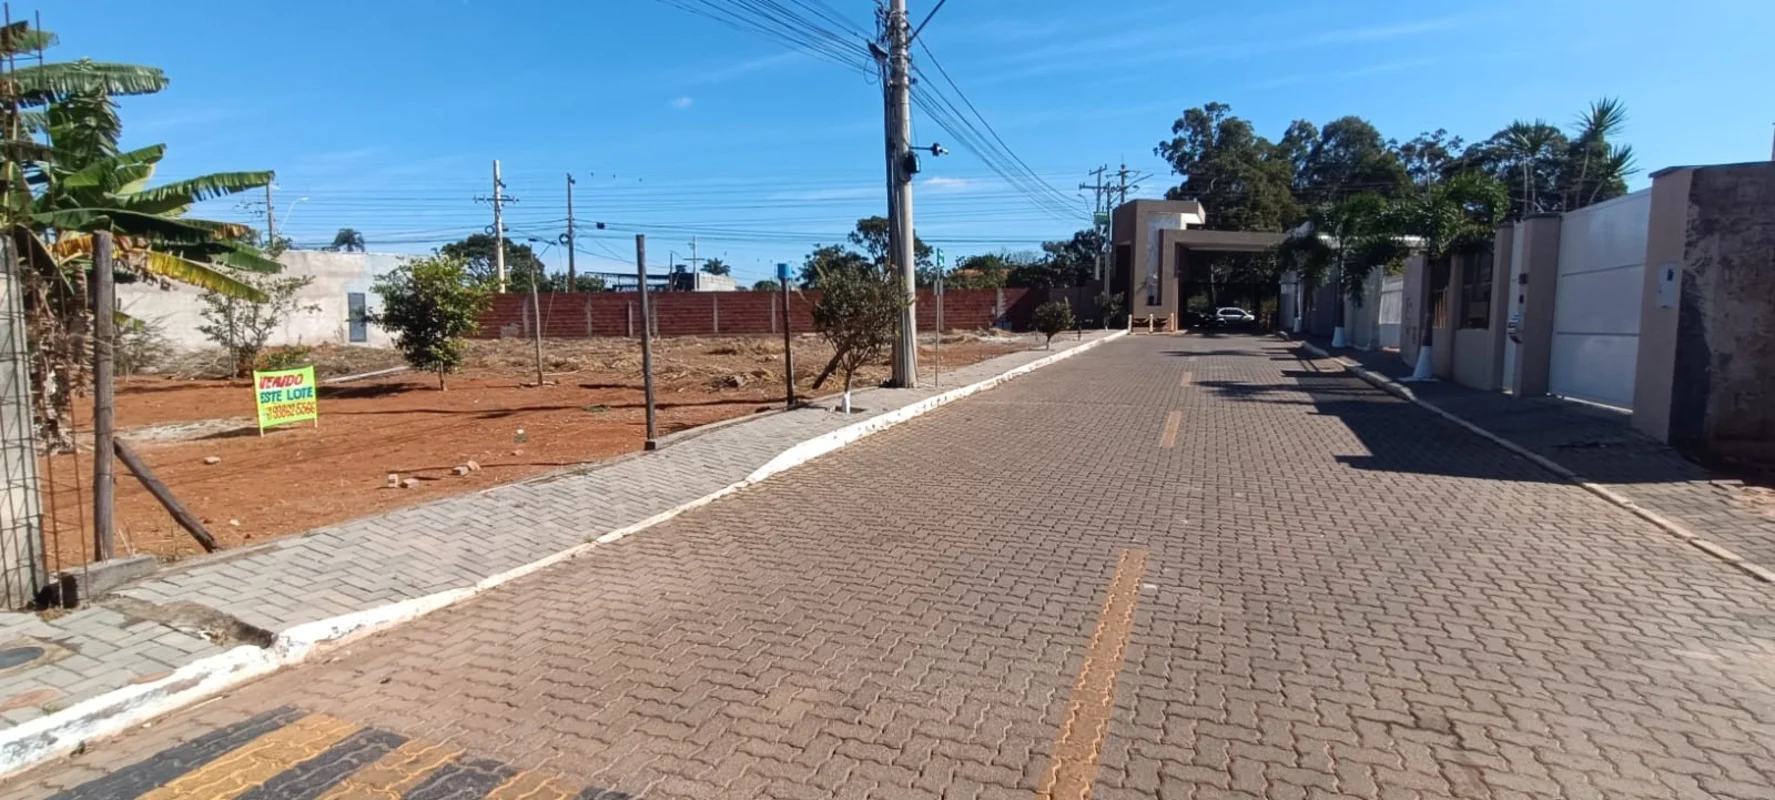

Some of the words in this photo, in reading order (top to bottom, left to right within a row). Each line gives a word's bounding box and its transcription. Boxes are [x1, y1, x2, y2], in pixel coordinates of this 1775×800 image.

[259, 374, 303, 389] VENDO
[260, 390, 282, 404] ESTE
[287, 386, 313, 401] LOTE
